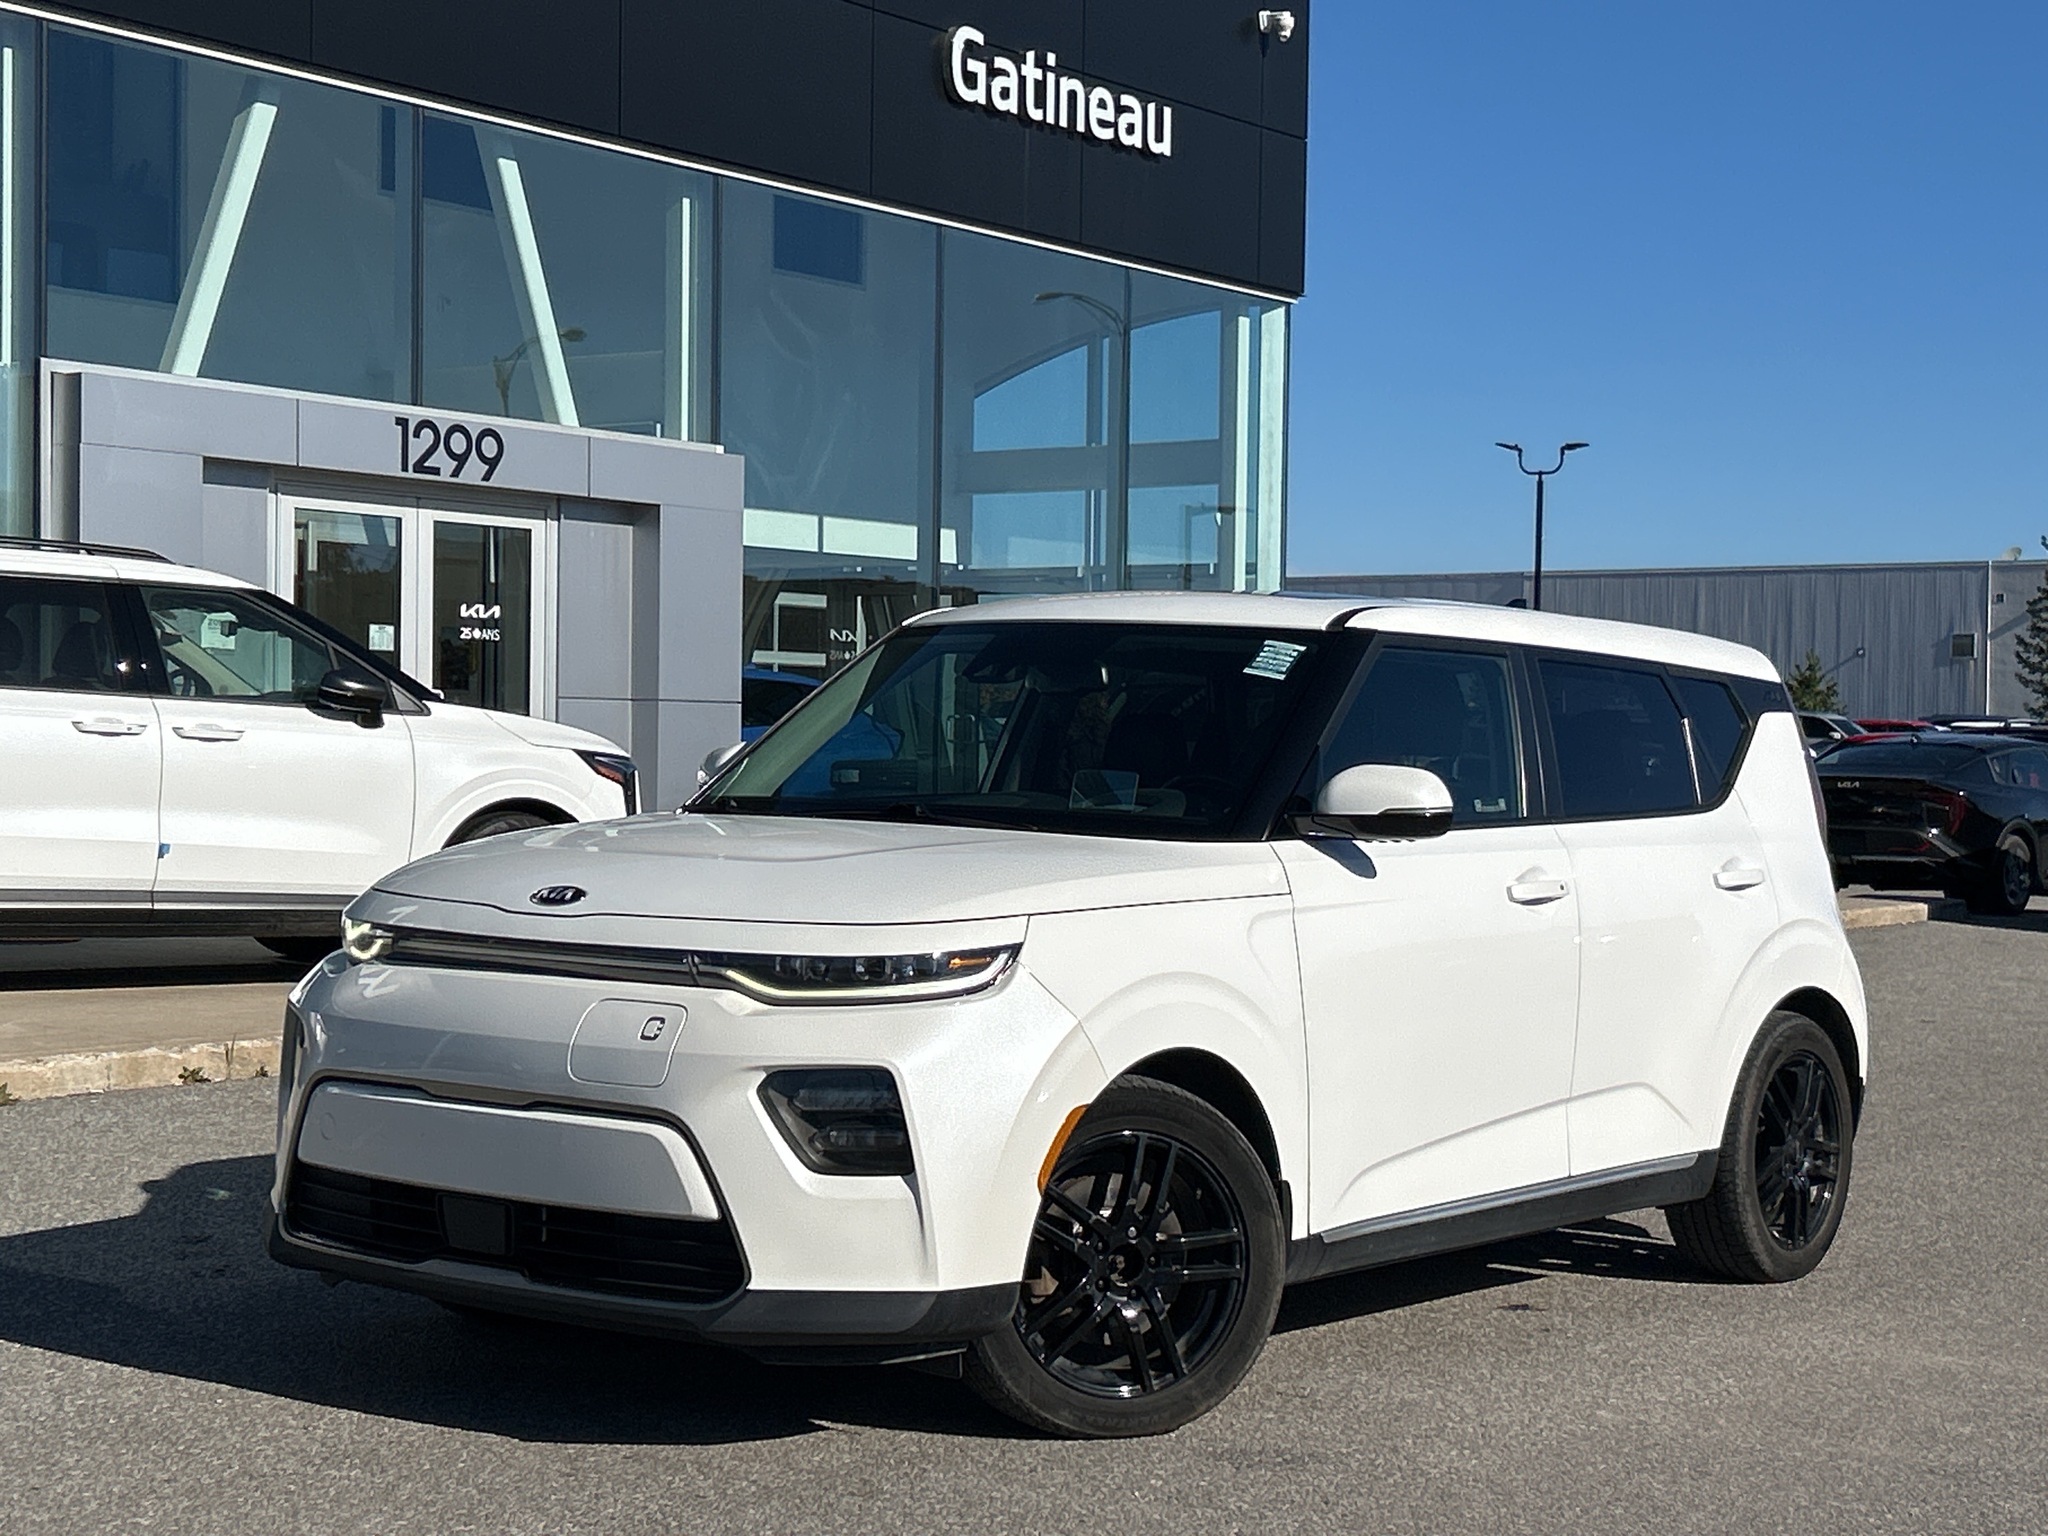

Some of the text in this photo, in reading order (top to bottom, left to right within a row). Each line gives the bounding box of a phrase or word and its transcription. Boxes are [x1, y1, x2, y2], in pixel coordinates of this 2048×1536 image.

[951, 25, 1172, 157] Gatineau
[394, 416, 504, 482] 1299
[460, 603, 501, 619] KIA
